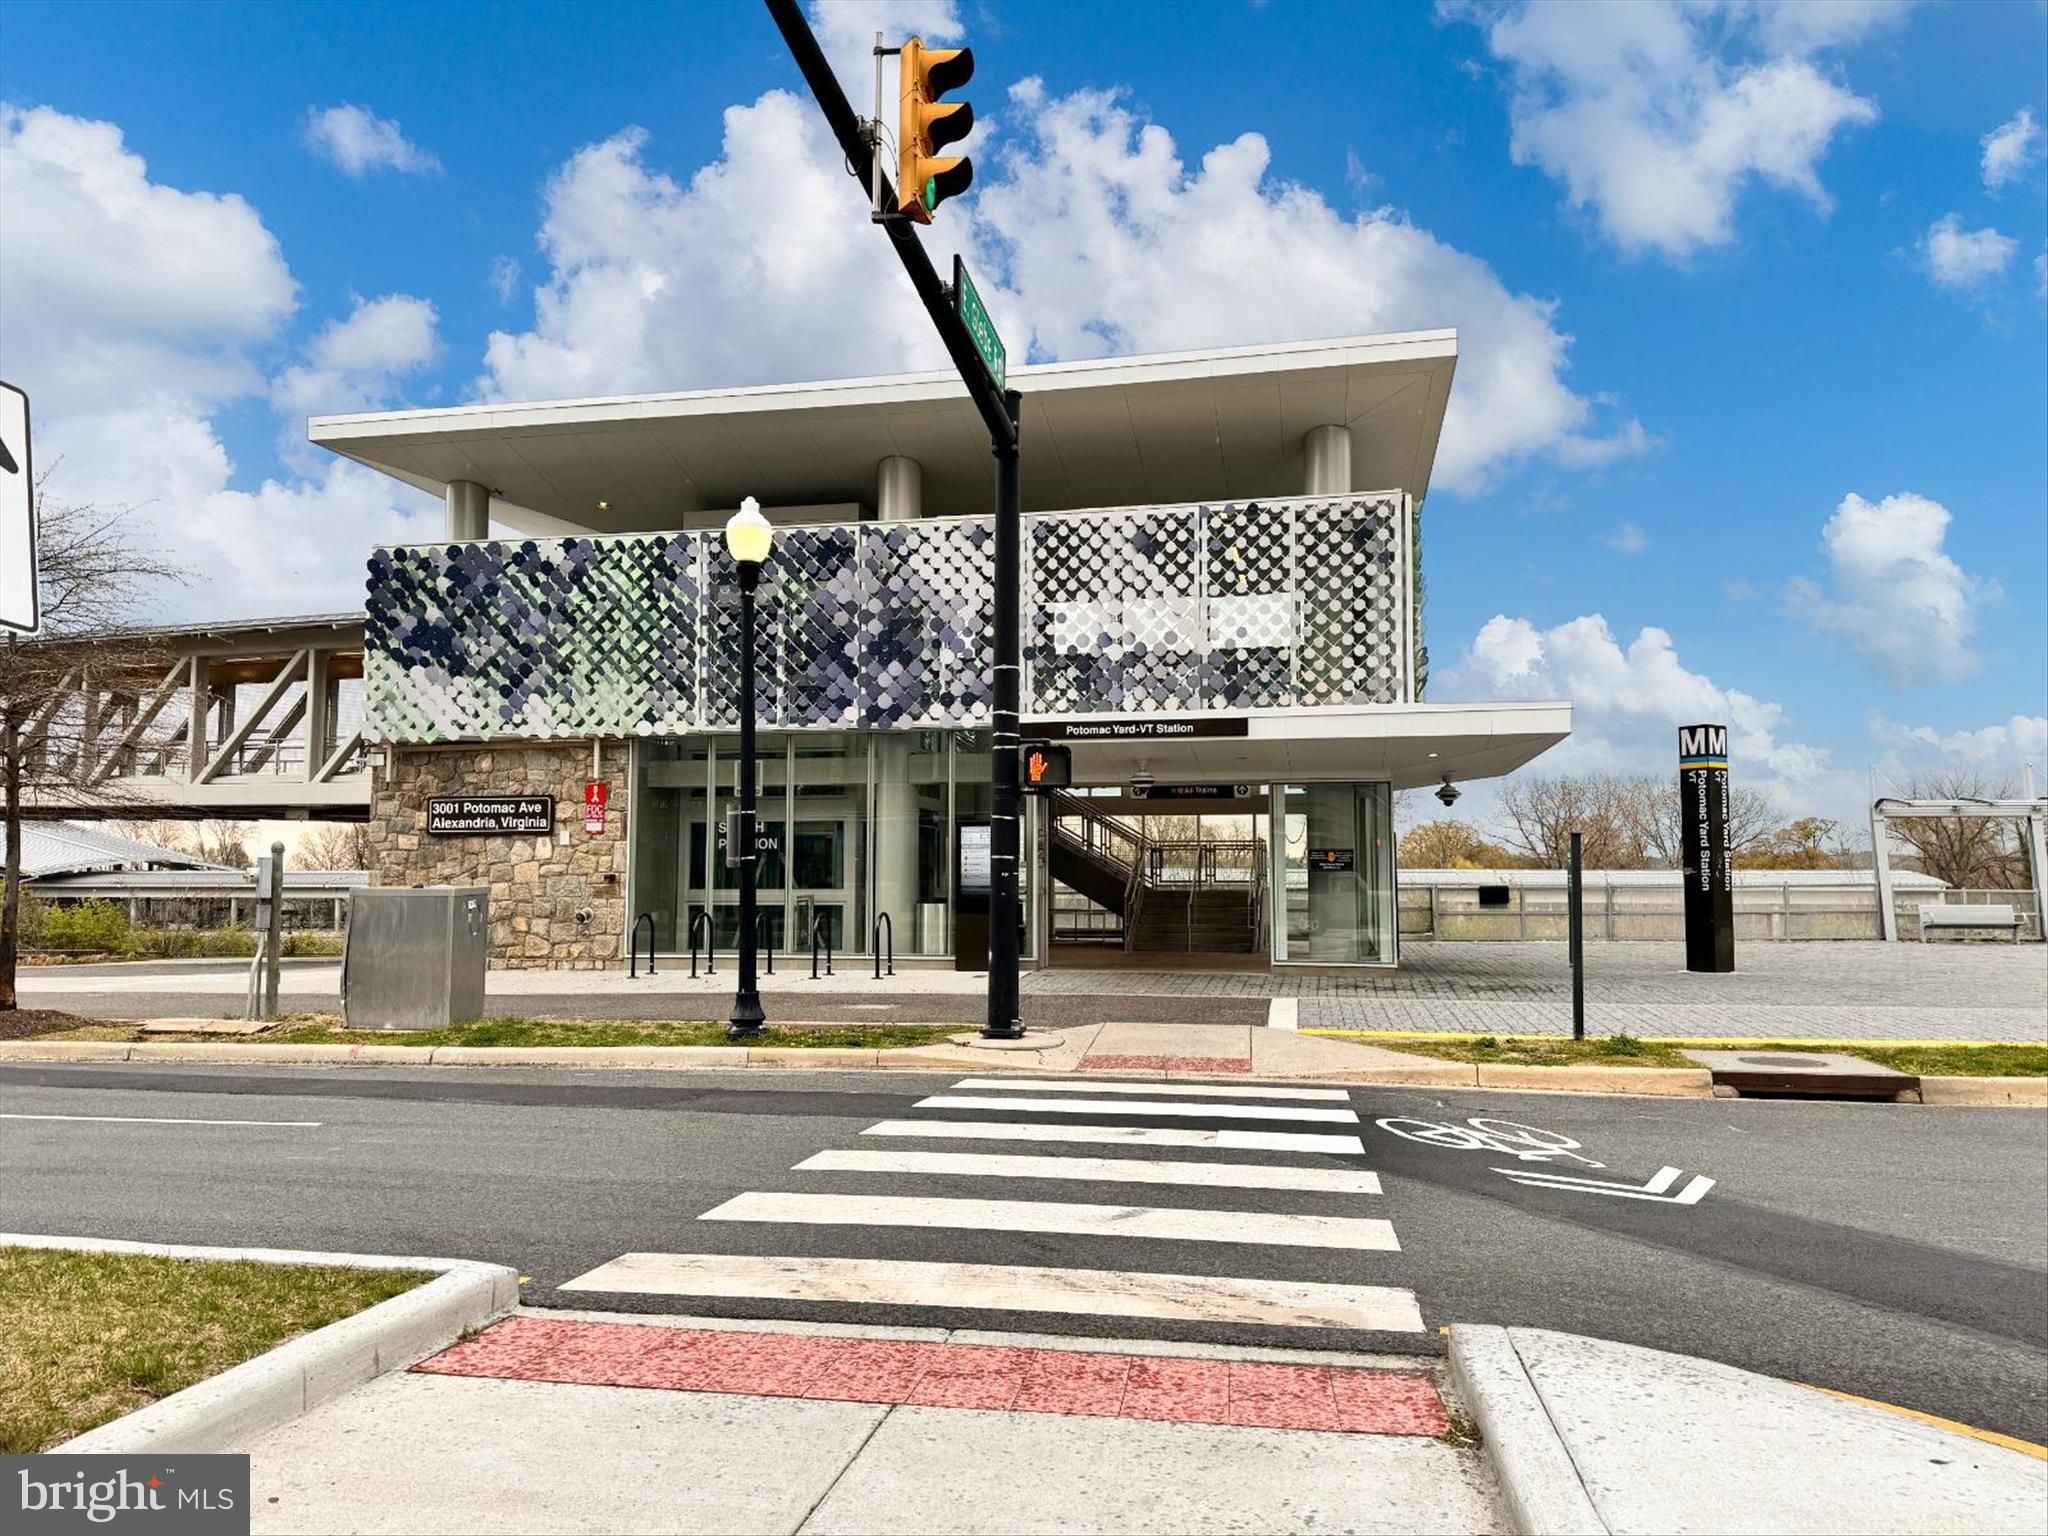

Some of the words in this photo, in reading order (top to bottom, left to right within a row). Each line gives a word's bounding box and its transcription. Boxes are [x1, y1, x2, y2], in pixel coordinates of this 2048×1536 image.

[1066, 725, 1111, 735] Potomac
[1112, 724, 1154, 734] Yard-VT
[1156, 723, 1194, 733] Station
[1680, 727, 1706, 756] M
[1708, 728, 1726, 755] M
[1688, 770, 1697, 783] VT
[432, 803, 459, 814] 3001
[463, 803, 516, 814] Potomac
[518, 802, 542, 813] Ave
[1698, 770, 1708, 820] Potomac
[432, 817, 499, 830] Alexandria,
[500, 816, 547, 830] Virginia
[1699, 821, 1710, 847] Yard
[1722, 820, 1730, 847] Yard
[1700, 850, 1710, 891] Station
[1723, 851, 1731, 891] Station
